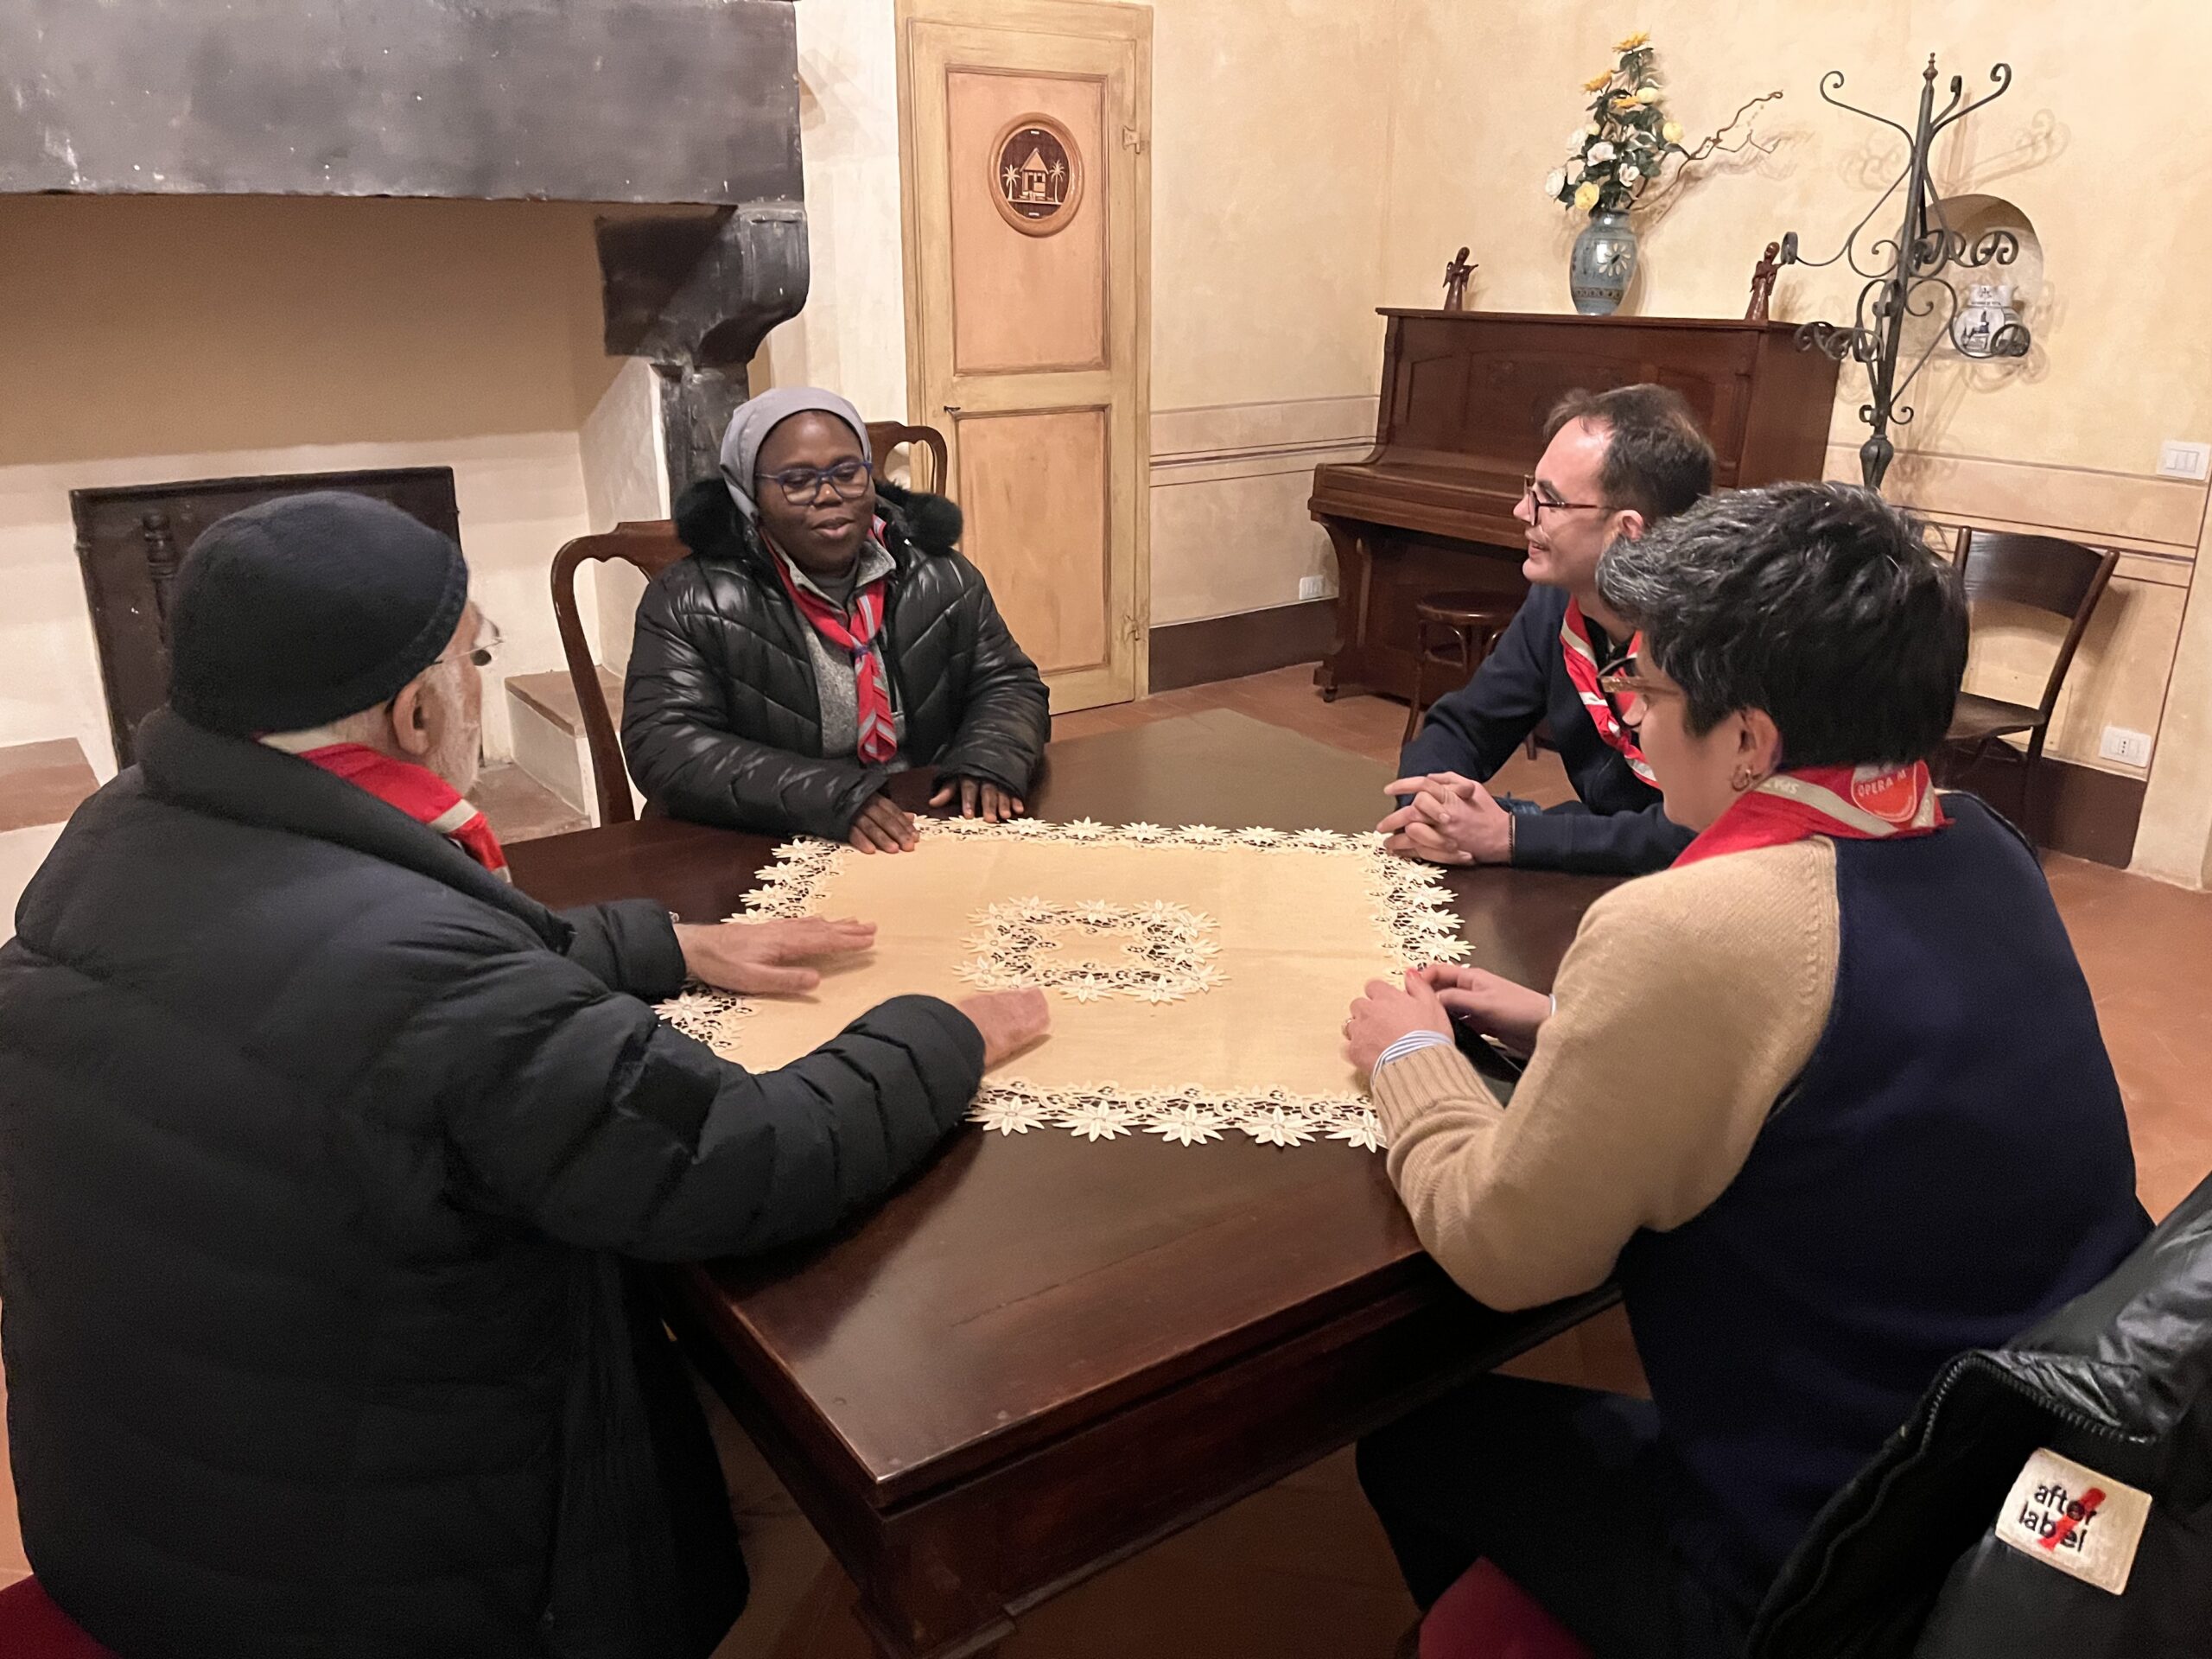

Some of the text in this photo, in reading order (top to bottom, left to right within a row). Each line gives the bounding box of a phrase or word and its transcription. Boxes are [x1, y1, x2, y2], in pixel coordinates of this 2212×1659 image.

[1858, 776, 1894, 798] OPERA
[2034, 1483, 2097, 1526] after
[2018, 1500, 2088, 1553] label
